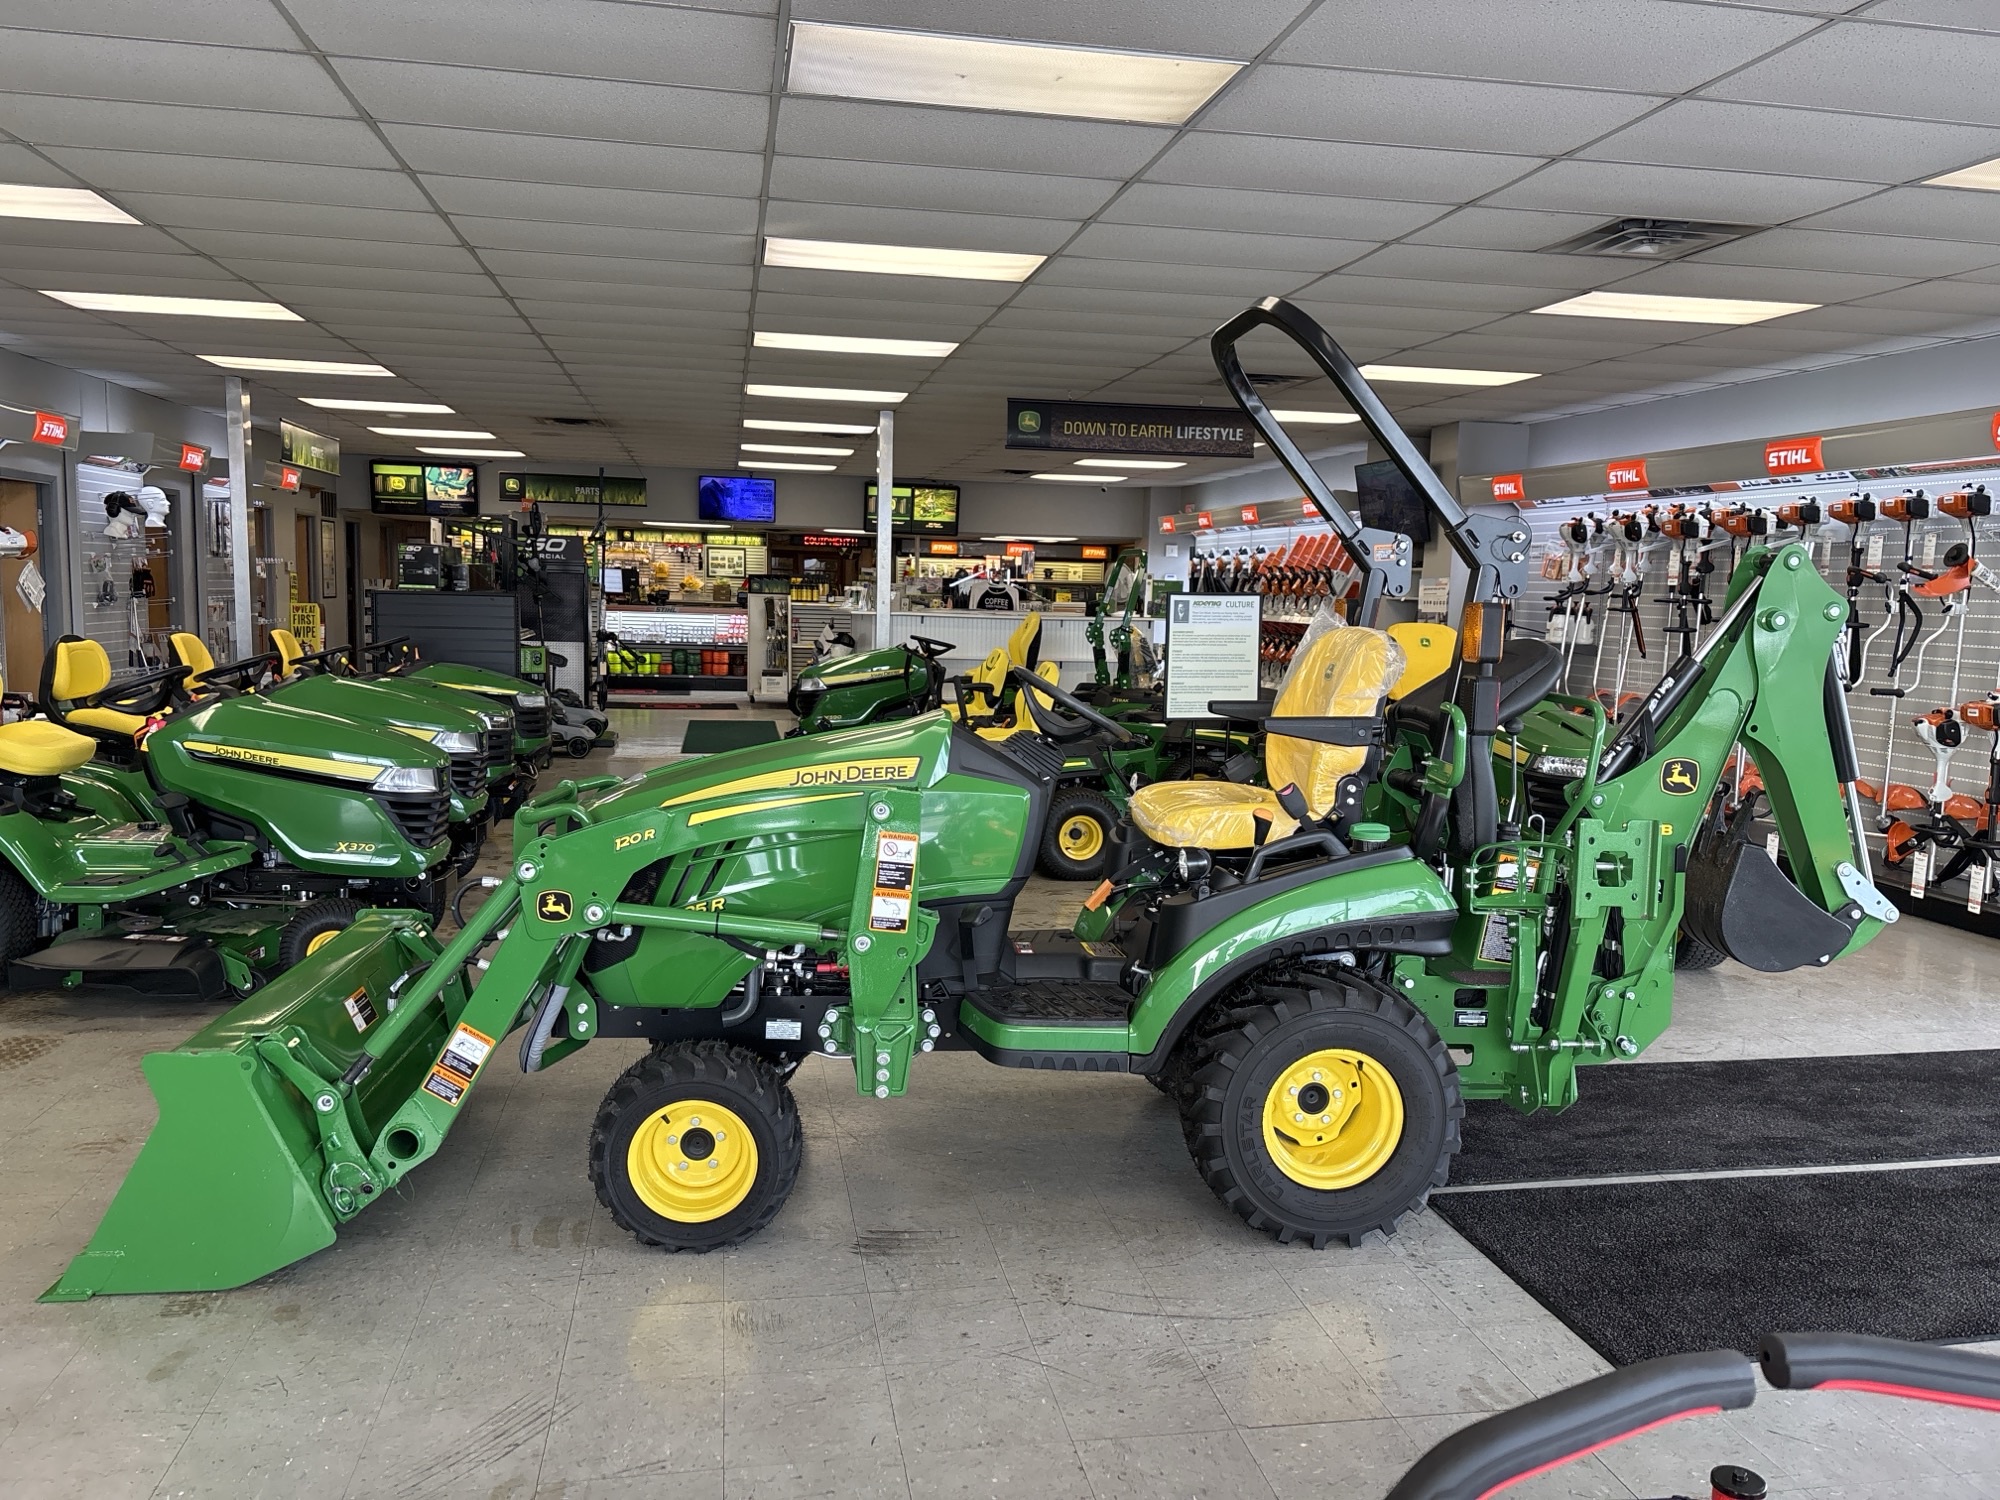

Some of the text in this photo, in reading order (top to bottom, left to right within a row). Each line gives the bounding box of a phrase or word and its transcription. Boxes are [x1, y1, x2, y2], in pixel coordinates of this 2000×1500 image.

[41, 423, 65, 438] STIHL
[1063, 421, 1244, 441] DOWN TO EARTH LIFESTYLE
[185, 453, 202, 466] STIHL
[1768, 448, 1811, 467] STIHL
[1609, 468, 1640, 484] STIHL
[575, 486, 600, 496] PARTS
[1493, 482, 1518, 496] STIHL
[984, 597, 1009, 607] COFFEE
[1225, 600, 1255, 608] CULTURE
[308, 605, 316, 613] AT
[292, 613, 316, 626] FIRST
[292, 626, 317, 639] WIPE
[211, 745, 280, 765] JOHN DEERE
[789, 765, 909, 786] JOHN DEERE
[614, 828, 657, 851] 120 R
[887, 834, 917, 842] WARNING
[335, 841, 376, 853] X370
[880, 891, 910, 899] WARNING
[468, 1029, 491, 1044] WARNING
[442, 1072, 465, 1087] WARNING
